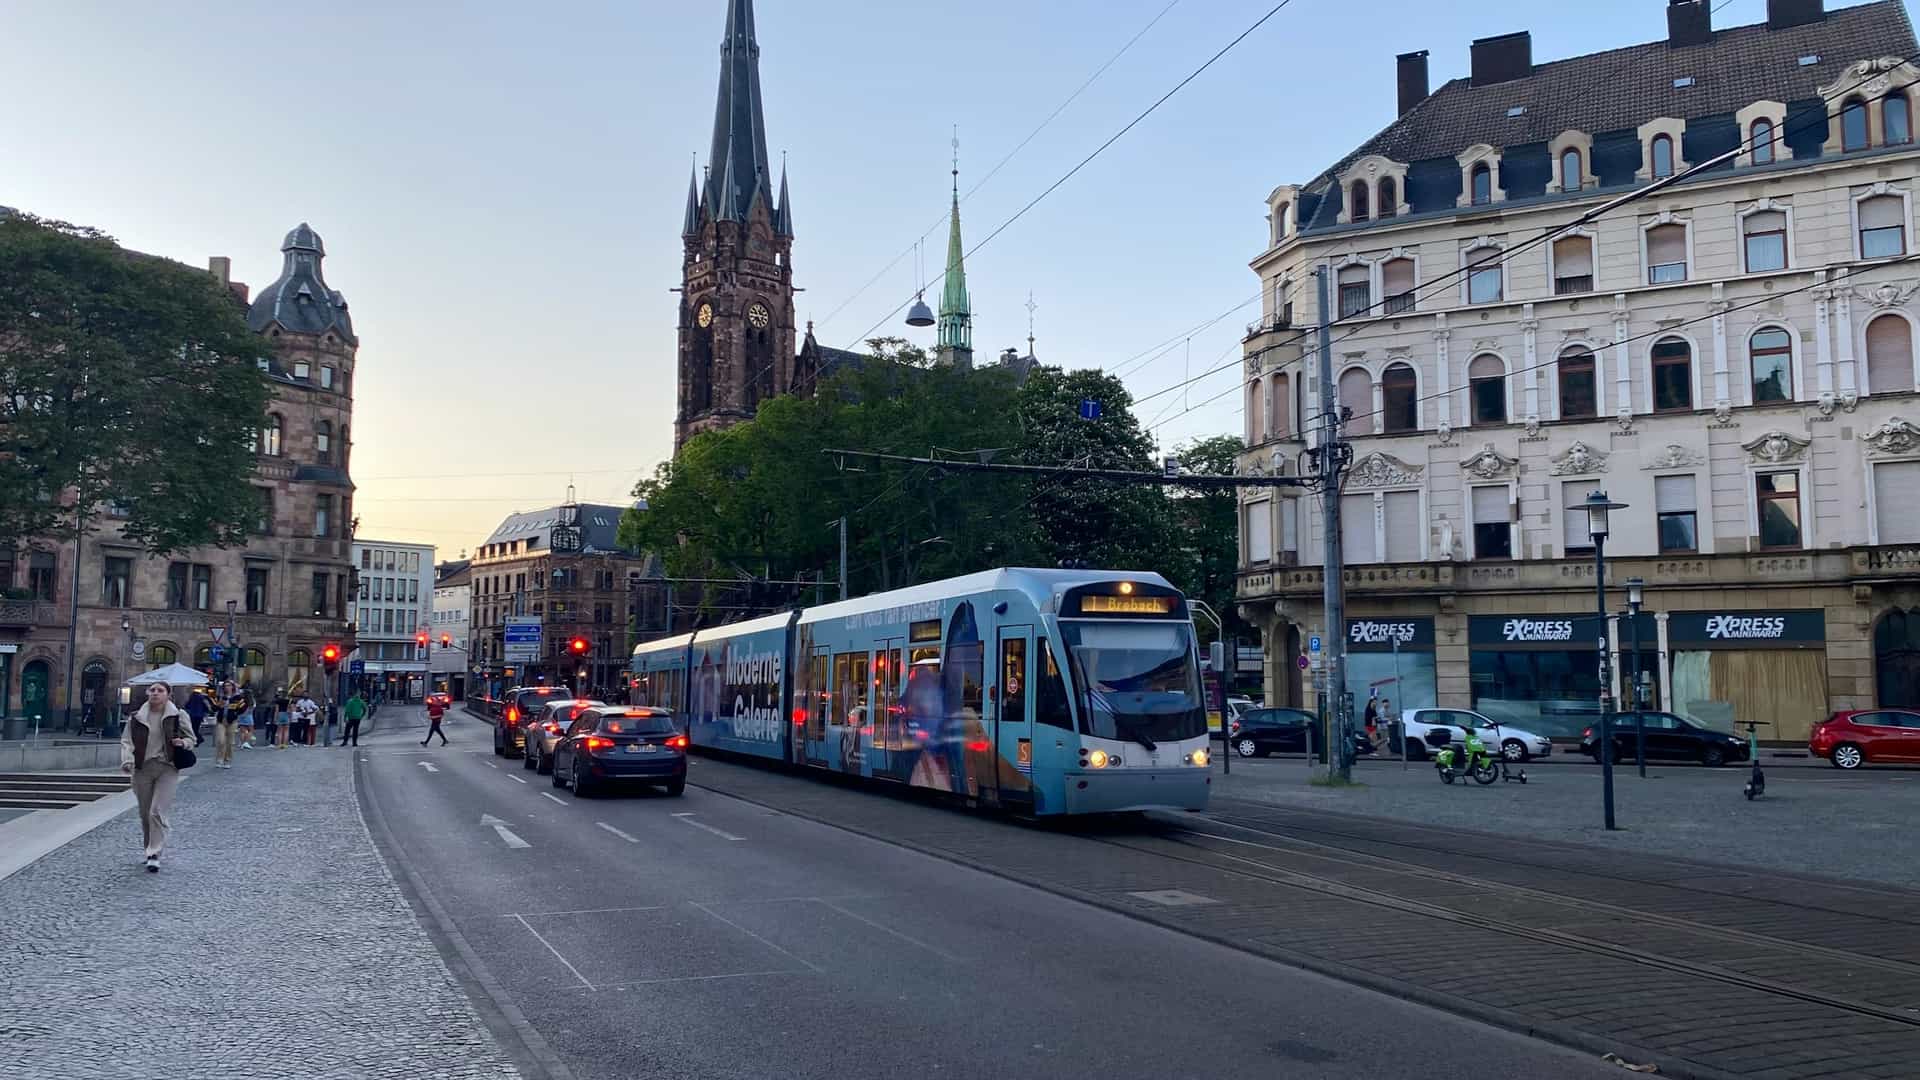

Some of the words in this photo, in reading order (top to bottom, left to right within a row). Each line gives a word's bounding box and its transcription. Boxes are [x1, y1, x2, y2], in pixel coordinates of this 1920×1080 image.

[1351, 621, 1415, 641] EXPRESS
[1503, 619, 1572, 640] EXPRESS
[1525, 632, 1571, 640] MINIMARKT
[1705, 615, 1784, 638] EXPRESS
[1729, 630, 1784, 638] MINIMARKT
[726, 641, 781, 686] Moderne
[734, 694, 779, 742] Galerie
